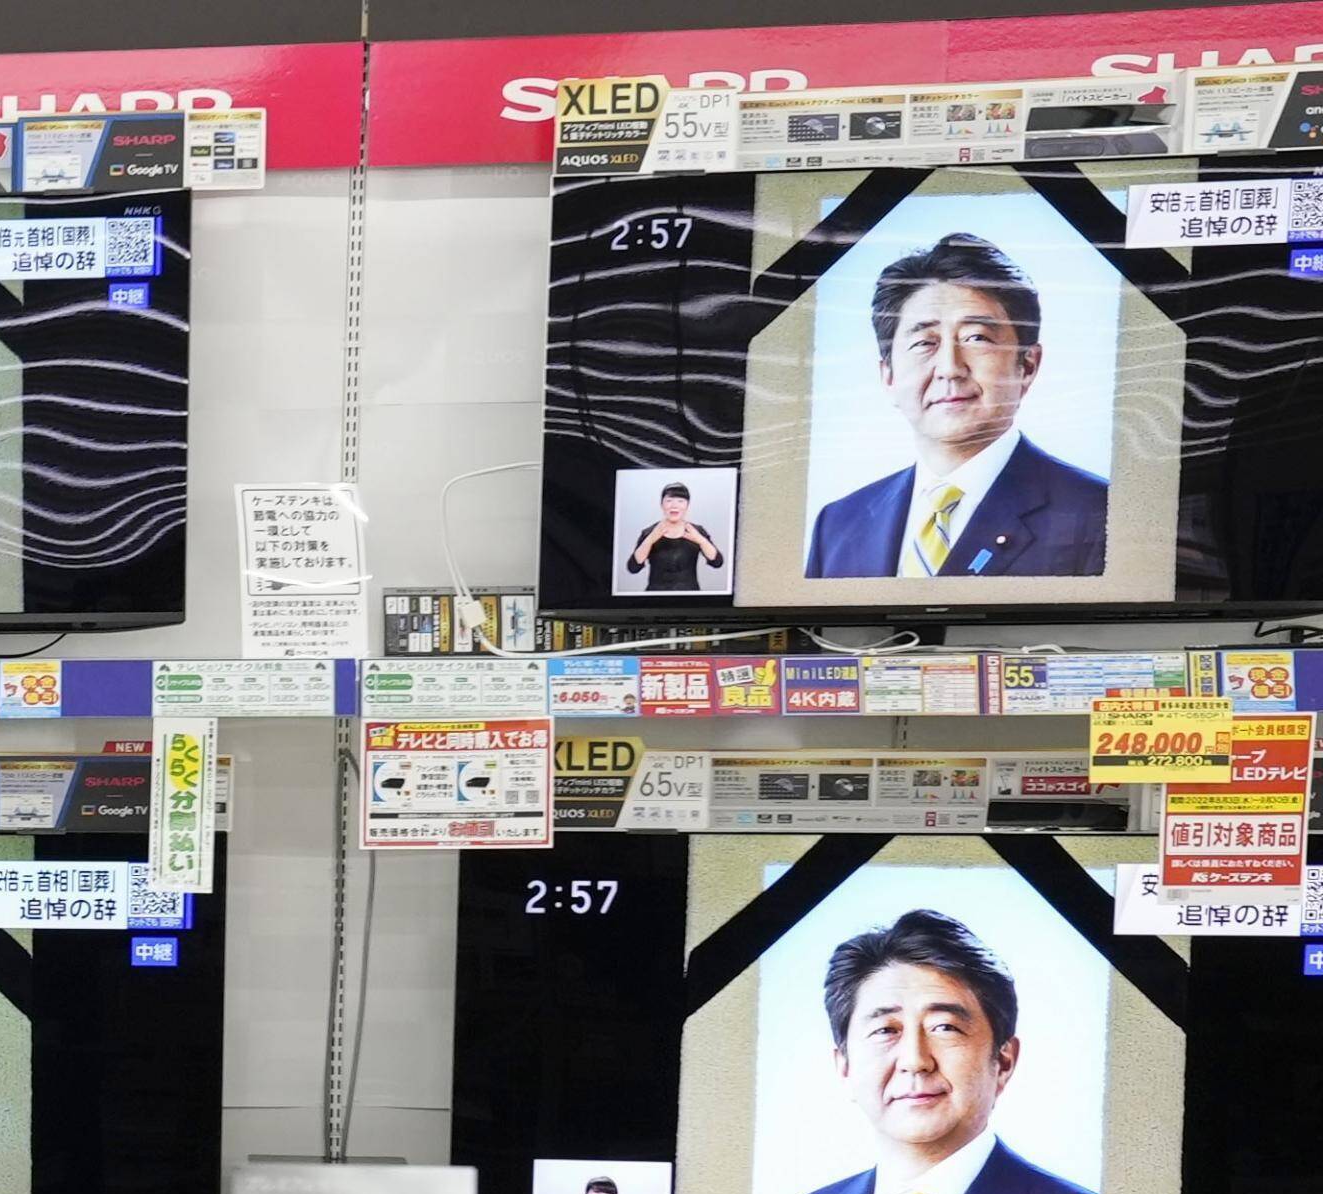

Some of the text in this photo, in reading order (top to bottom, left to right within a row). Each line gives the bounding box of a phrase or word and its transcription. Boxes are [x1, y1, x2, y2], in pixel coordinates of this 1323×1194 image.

[561, 82, 660, 116] XLED
[700, 94, 730, 109] DP1
[665, 112, 729, 138] 55V型
[112, 134, 176, 147] SHARP
[561, 153, 638, 166] AQUOS XLED
[127, 163, 179, 177] Google TV
[1150, 188, 1278, 213] 安倍元首相「国葬」
[123, 207, 151, 216] NHK
[611, 218, 693, 250] 2:57
[1180, 216, 1277, 239] 追悼の辞
[12, 250, 96, 271] 追悼の辞
[113, 288, 144, 305] 中継
[720, 667, 752, 683] 特選
[641, 675, 708, 700] 新製品
[721, 687, 772, 707] 良品
[788, 691, 855, 707] 4K内蔵
[115, 742, 144, 752] NEW
[675, 755, 704, 770] DP1
[85, 776, 144, 788] SHARP
[639, 772, 702, 797] 65V型
[98, 806, 148, 817] Google TV
[587, 808, 615, 818] XLED
[1172, 822, 1297, 847] 値引対象商品
[1210, 872, 1273, 882] ケーズデンキ
[525, 880, 619, 914] 2:57
[20, 899, 116, 921] 追悼の辞
[1177, 905, 1289, 927] 追悼の辞
[135, 944, 172, 961] 中継
